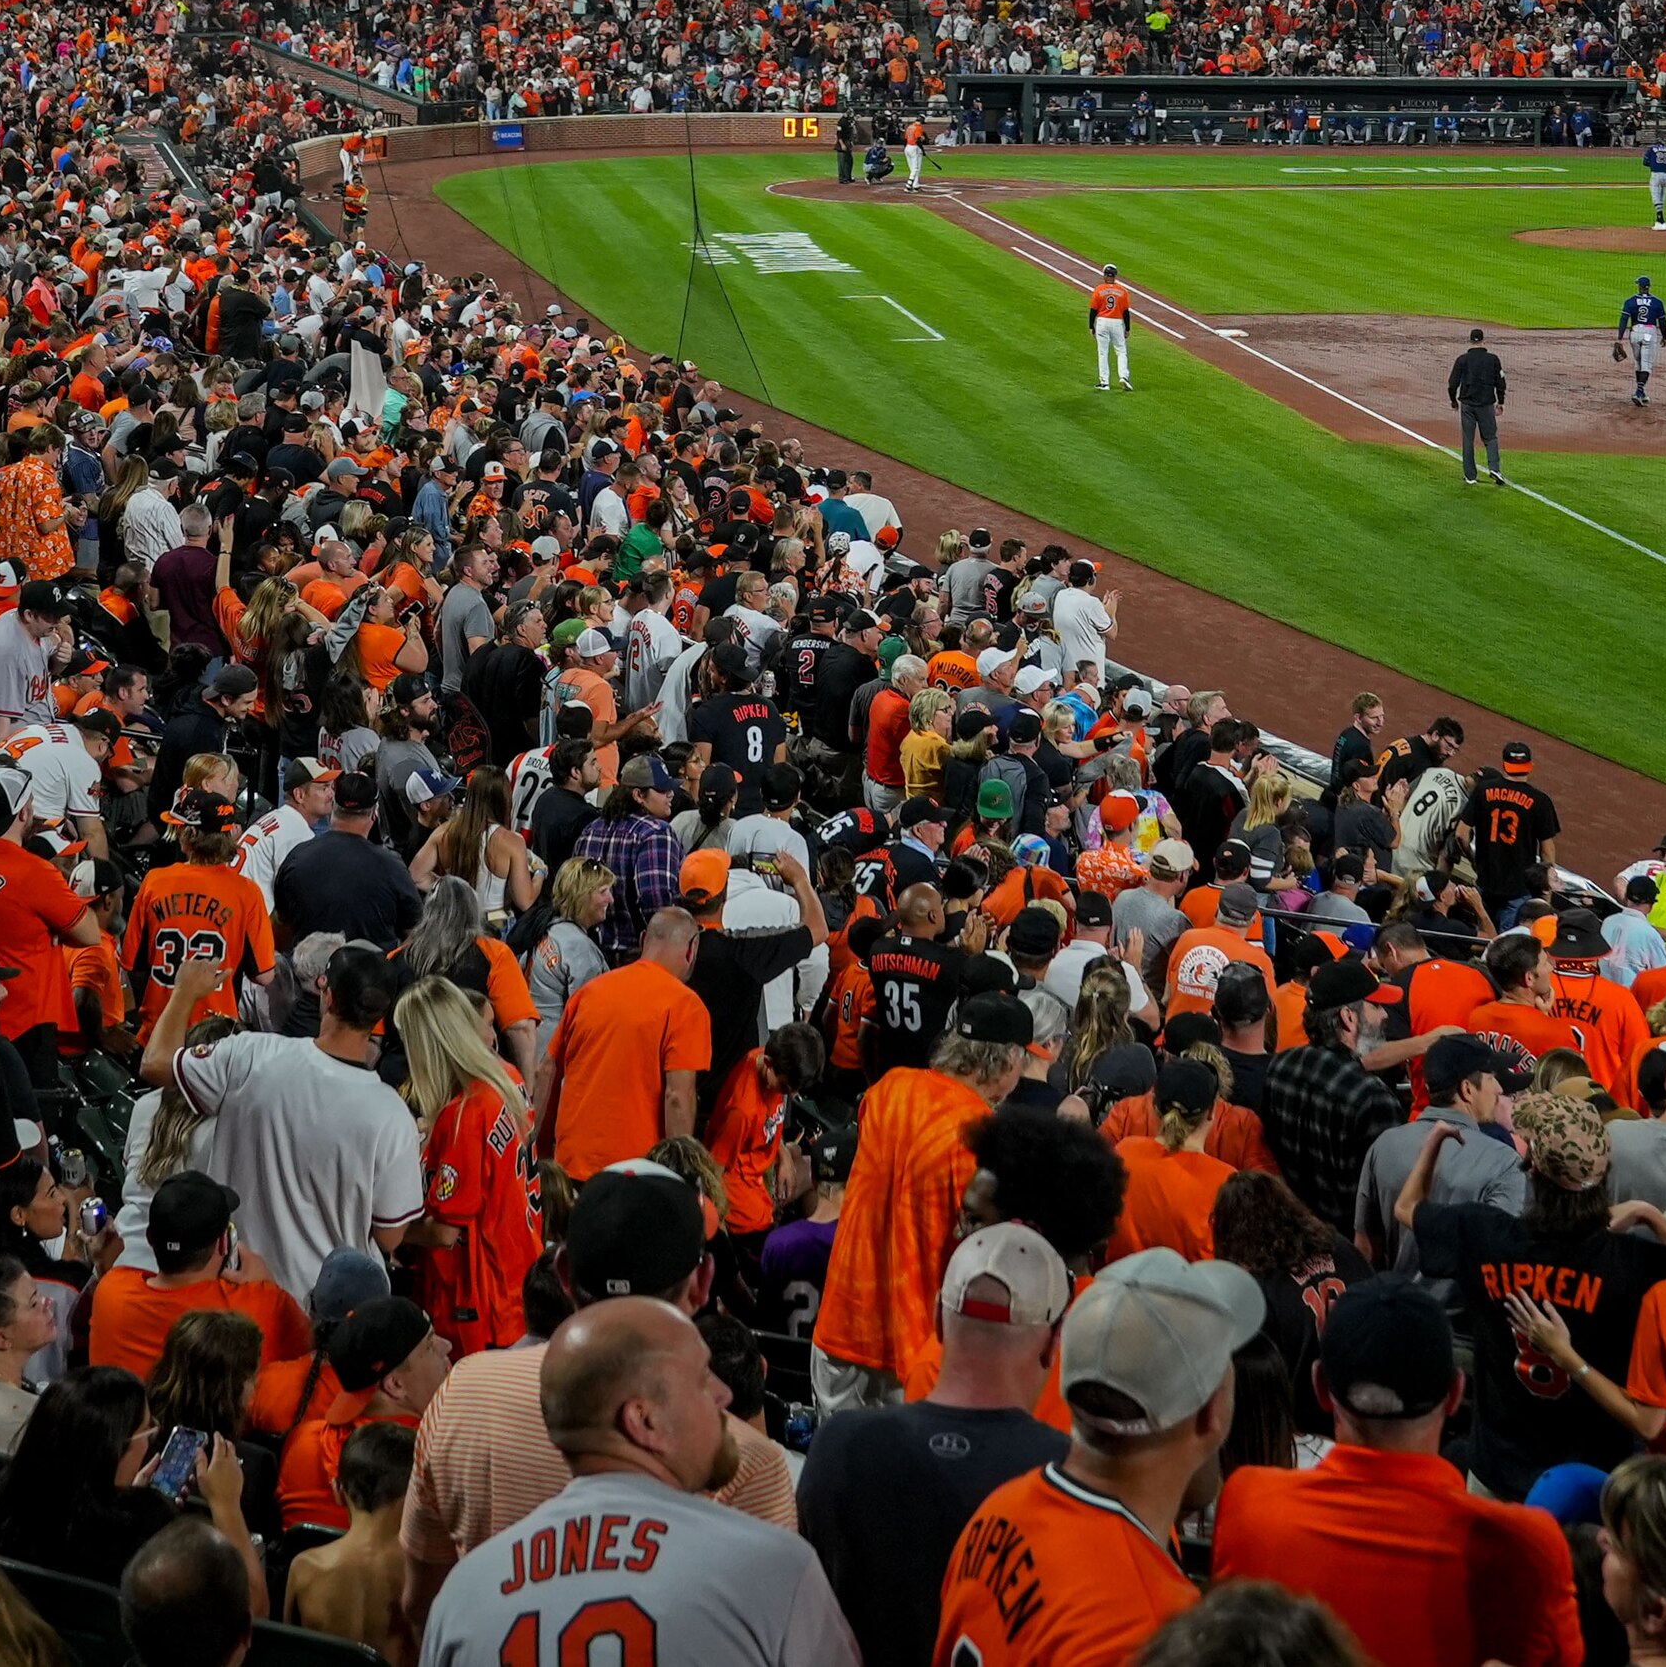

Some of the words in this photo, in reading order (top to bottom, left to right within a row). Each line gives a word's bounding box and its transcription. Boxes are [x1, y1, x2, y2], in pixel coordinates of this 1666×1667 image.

[1283, 98, 1321, 110] LEOM
[783, 118, 796, 137] 0
[803, 118, 819, 137] 15
[1106, 295, 1115, 310] 9
[1637, 306, 1648, 323] 2
[791, 639, 831, 650] HENDERSON
[798, 650, 815, 685] 2
[733, 703, 769, 723] RIPKEN
[746, 725, 763, 762] 8
[1413, 790, 1438, 817] 8
[1433, 772, 1459, 811] RIPKEN
[1486, 787, 1534, 811] MACHADO
[1490, 797, 1520, 845] 13
[152, 893, 234, 927] WIETERS
[871, 953, 941, 982] RUTSCHMAN
[841, 989, 852, 1024] 8
[884, 980, 922, 1032] 35
[1481, 1262, 1603, 1314] RIPKEN
[501, 1514, 667, 1595] JONES
[956, 1514, 1044, 1645] RIPKEN
